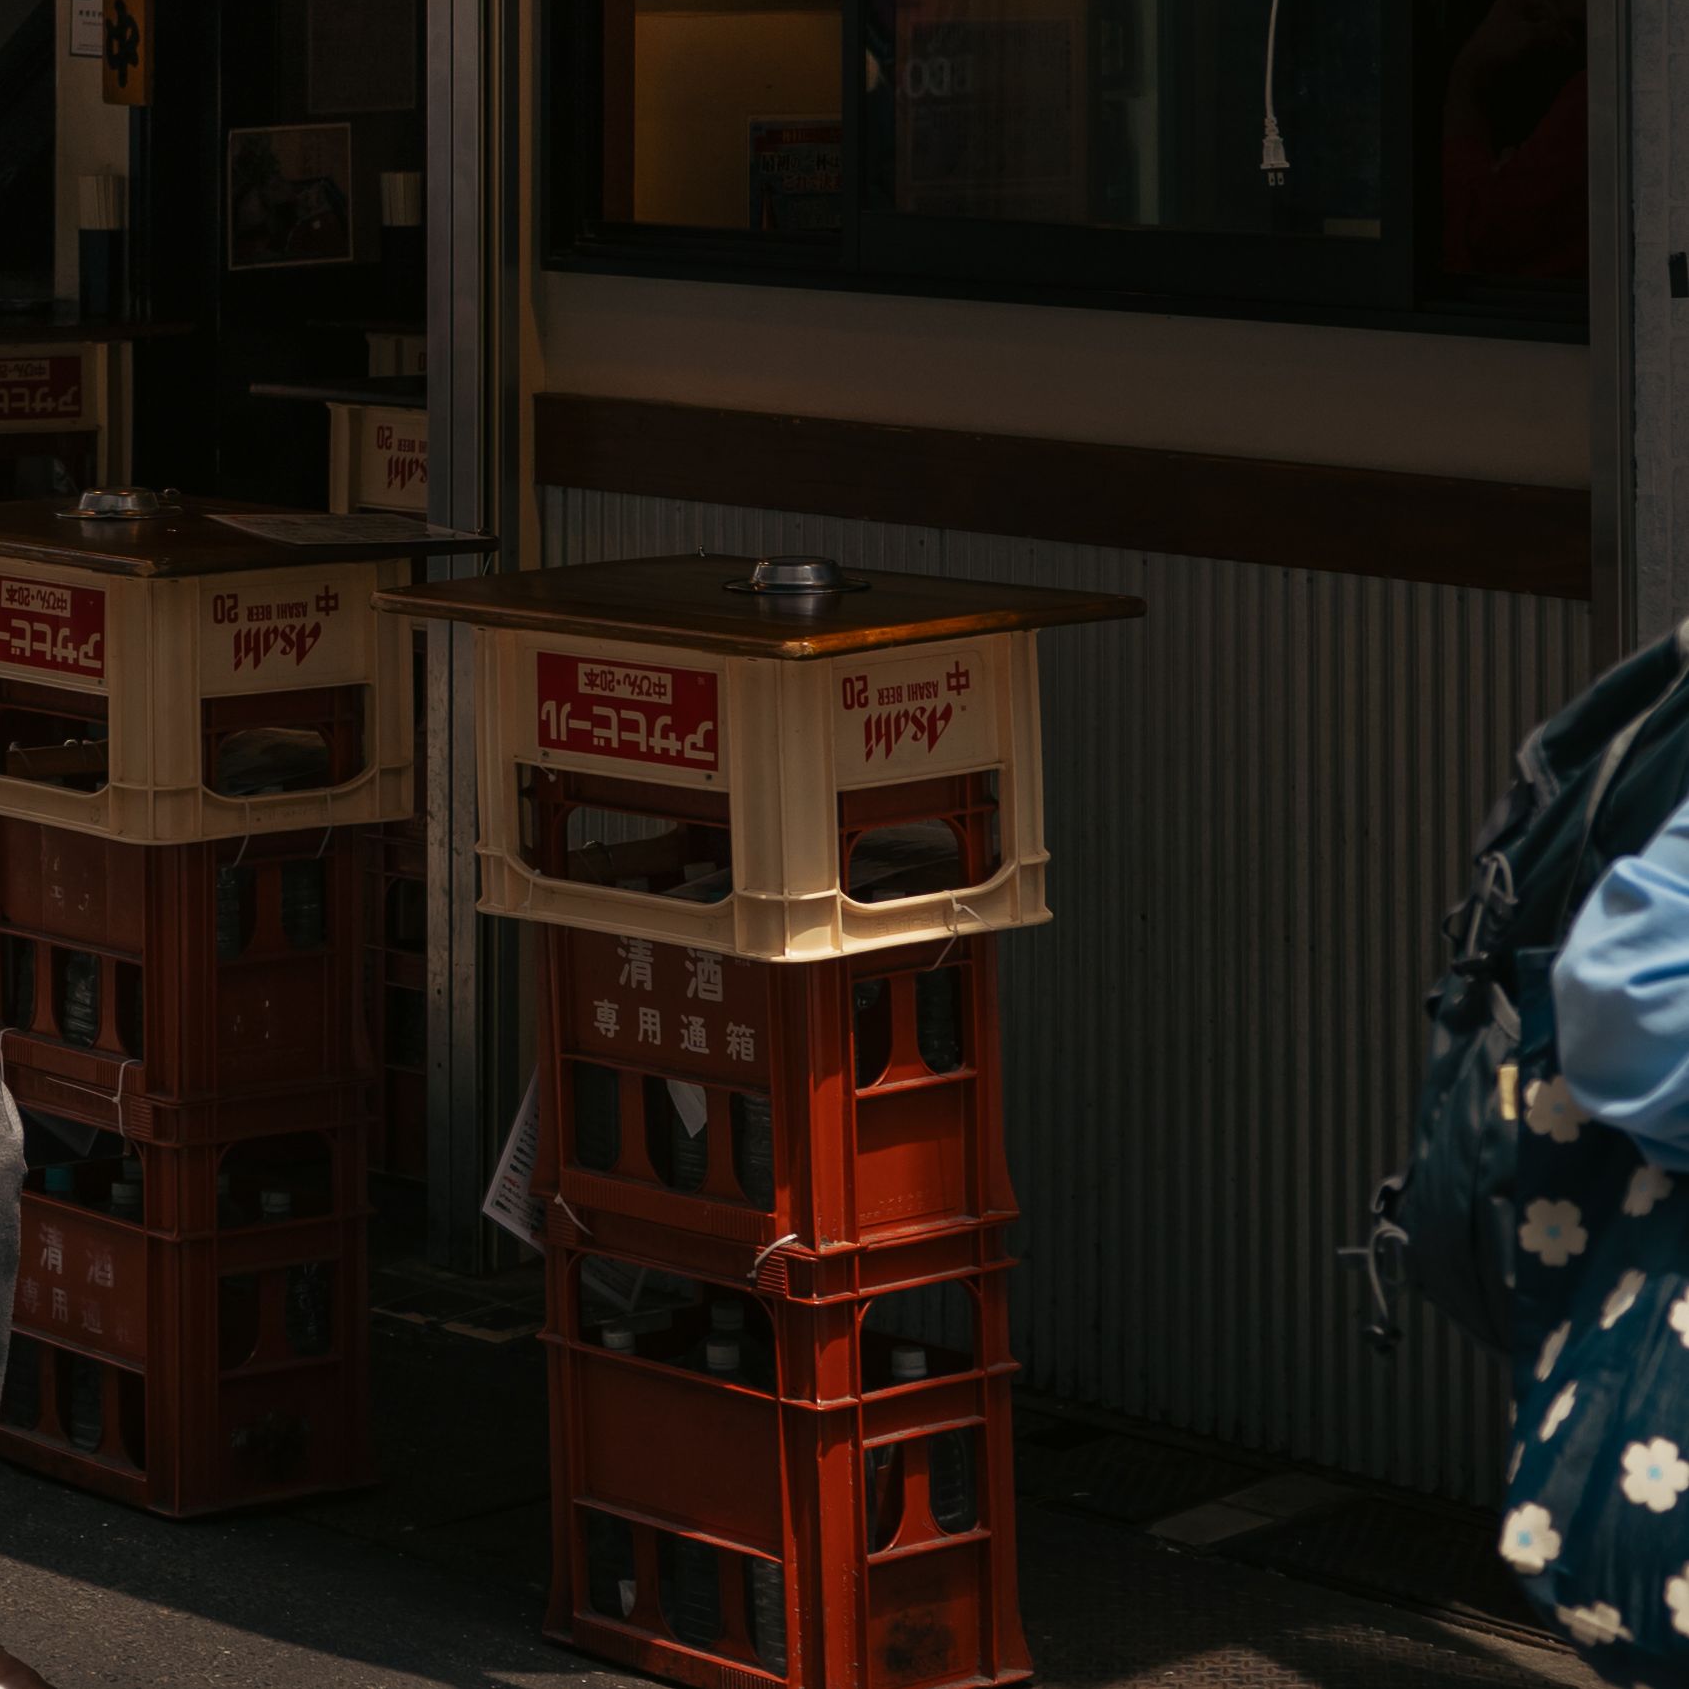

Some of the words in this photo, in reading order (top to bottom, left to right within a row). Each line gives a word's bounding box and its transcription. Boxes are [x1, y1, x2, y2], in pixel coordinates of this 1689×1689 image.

[377, 425, 393, 450] 20
[213, 593, 239, 624] 20
[247, 605, 273, 623] BEER
[275, 602, 308, 620] ASAHI
[315, 586, 339, 617] 中
[233, 623, 322, 672] Asahi
[841, 675, 869, 710] 20
[876, 684, 902, 706] BEER
[905, 678, 940, 703] ASAHI
[946, 660, 970, 696] 中
[541, 699, 716, 763] アサヒビール
[864, 703, 953, 763] Asahi
[617, 936, 724, 1003] 清酒
[593, 998, 756, 1063] 専用通箱
[22, 1276, 134, 1344] 専用通
